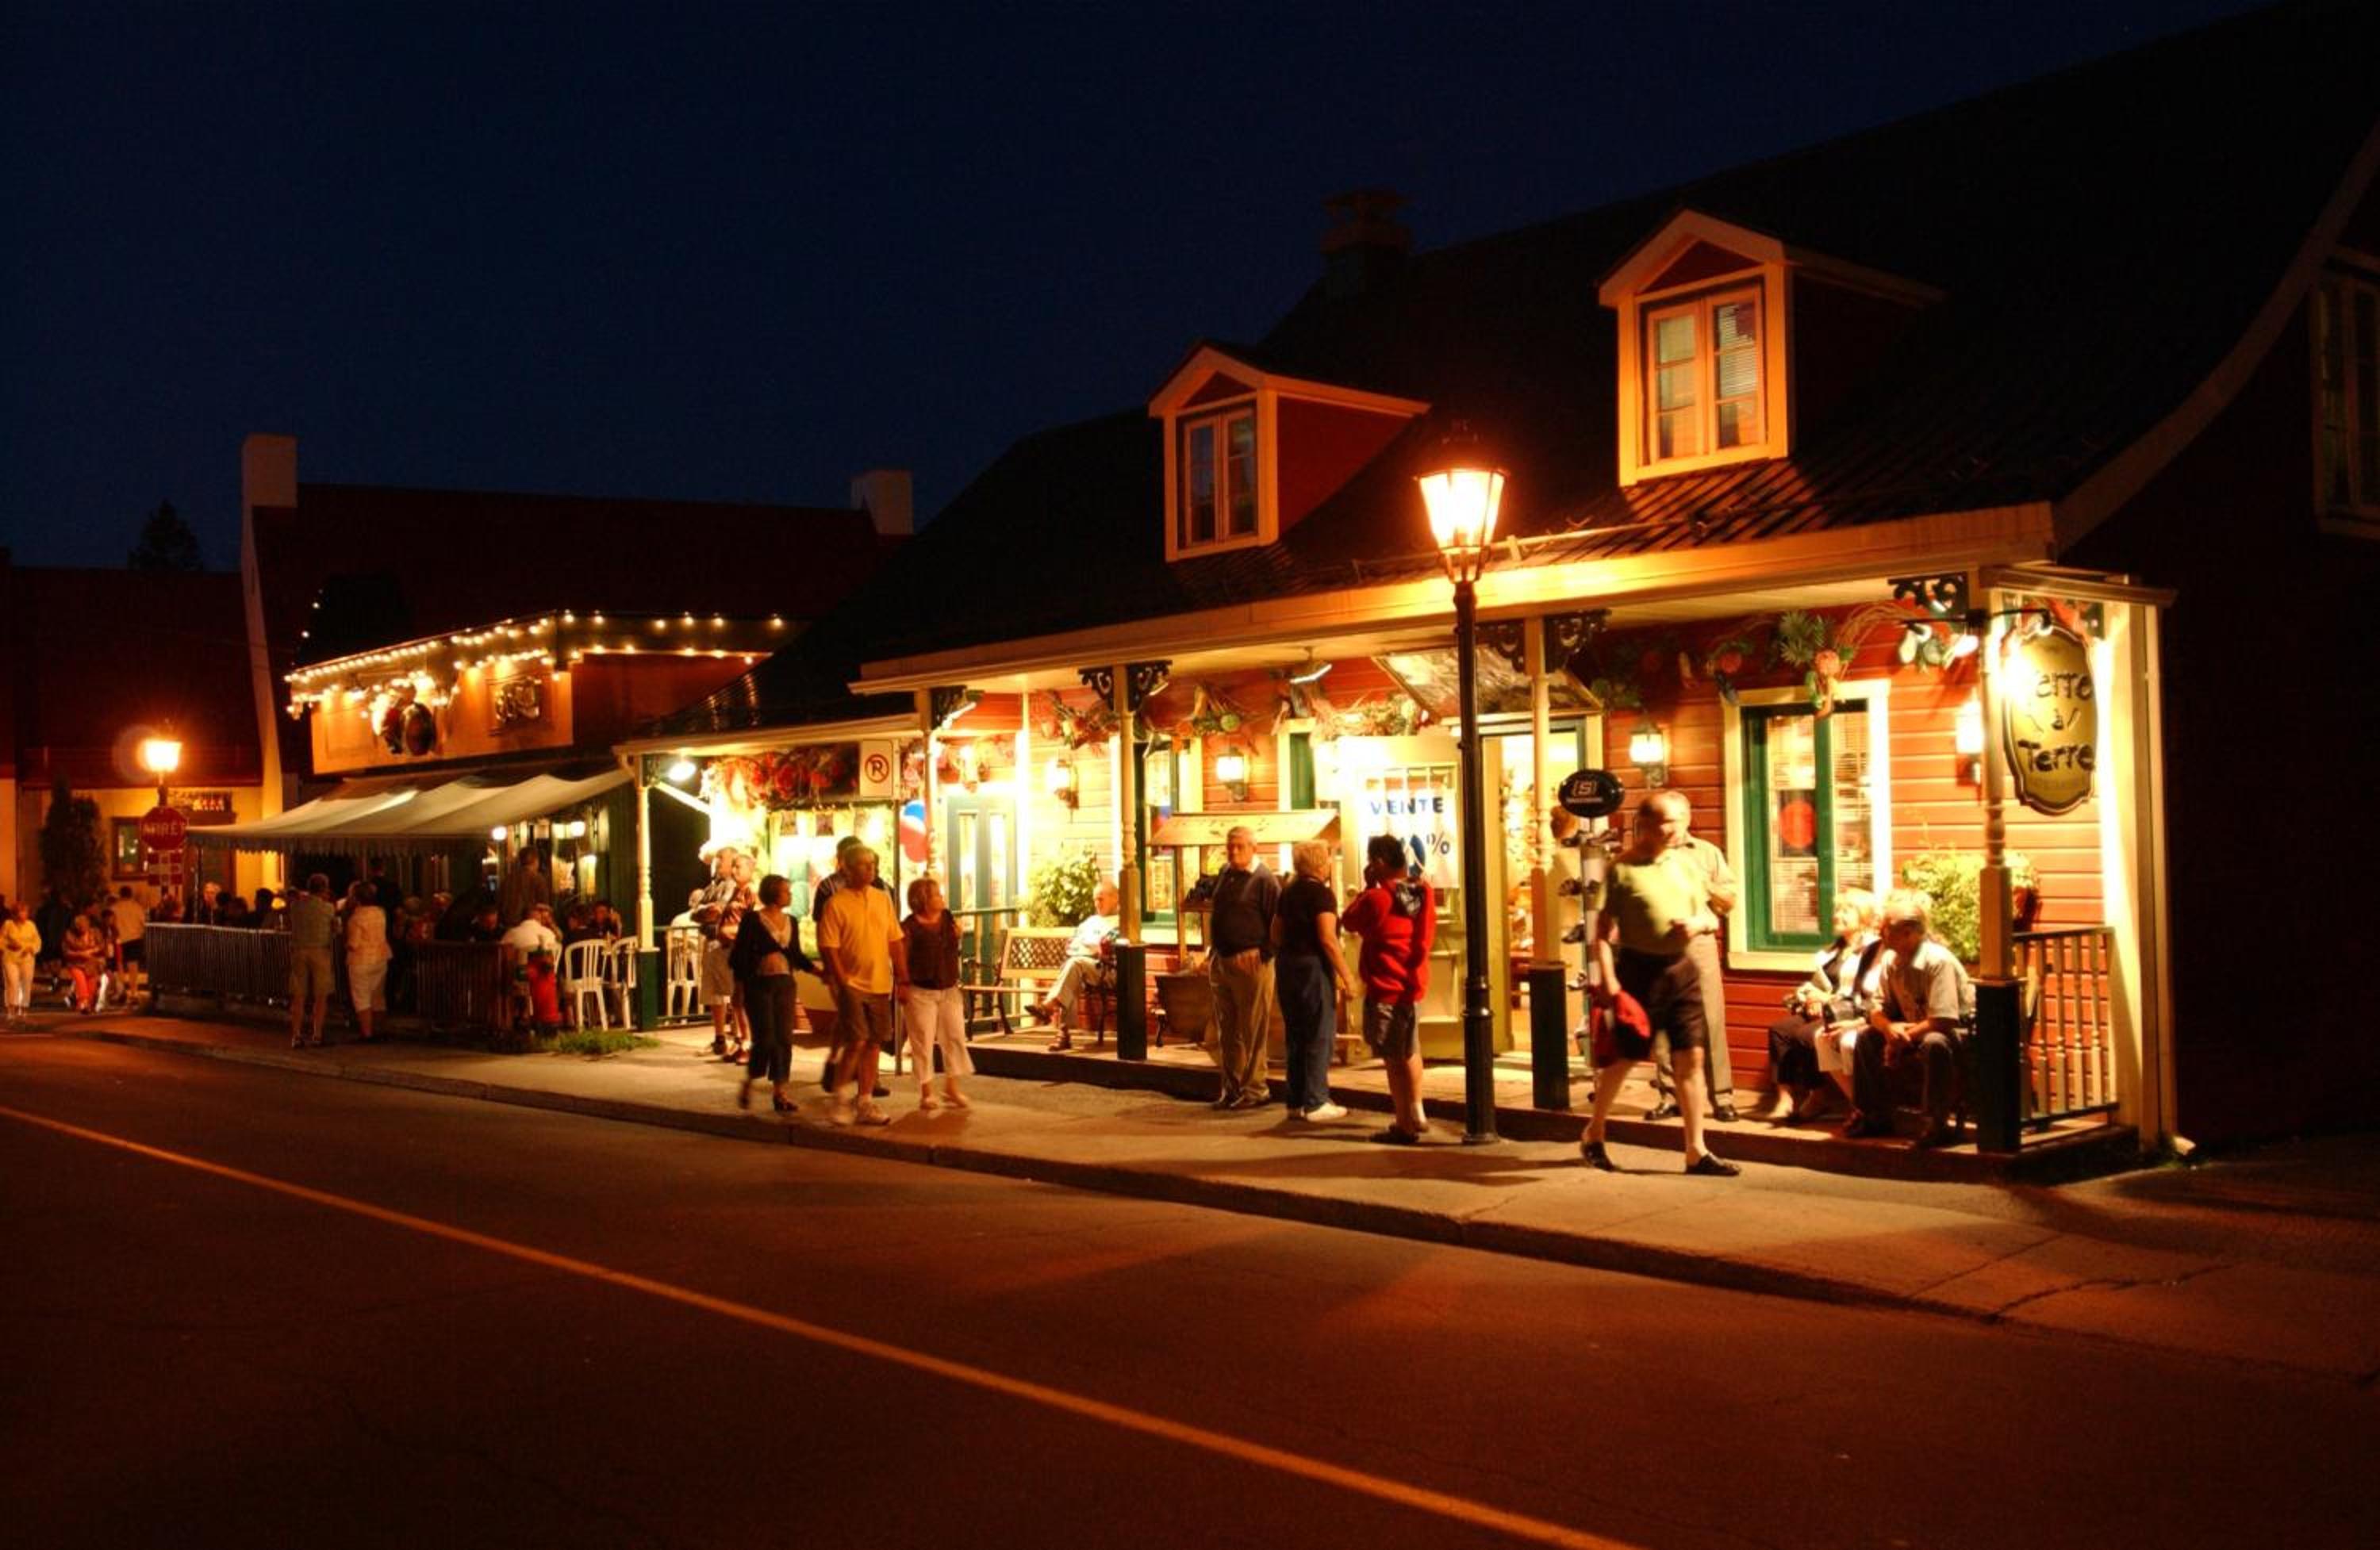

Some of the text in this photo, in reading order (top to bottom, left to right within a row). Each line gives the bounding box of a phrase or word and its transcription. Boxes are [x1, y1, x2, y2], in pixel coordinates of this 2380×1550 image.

[2035, 672, 2094, 700] erre
[2017, 739, 2095, 773] Terre
[1370, 796, 1444, 815] VENTE
